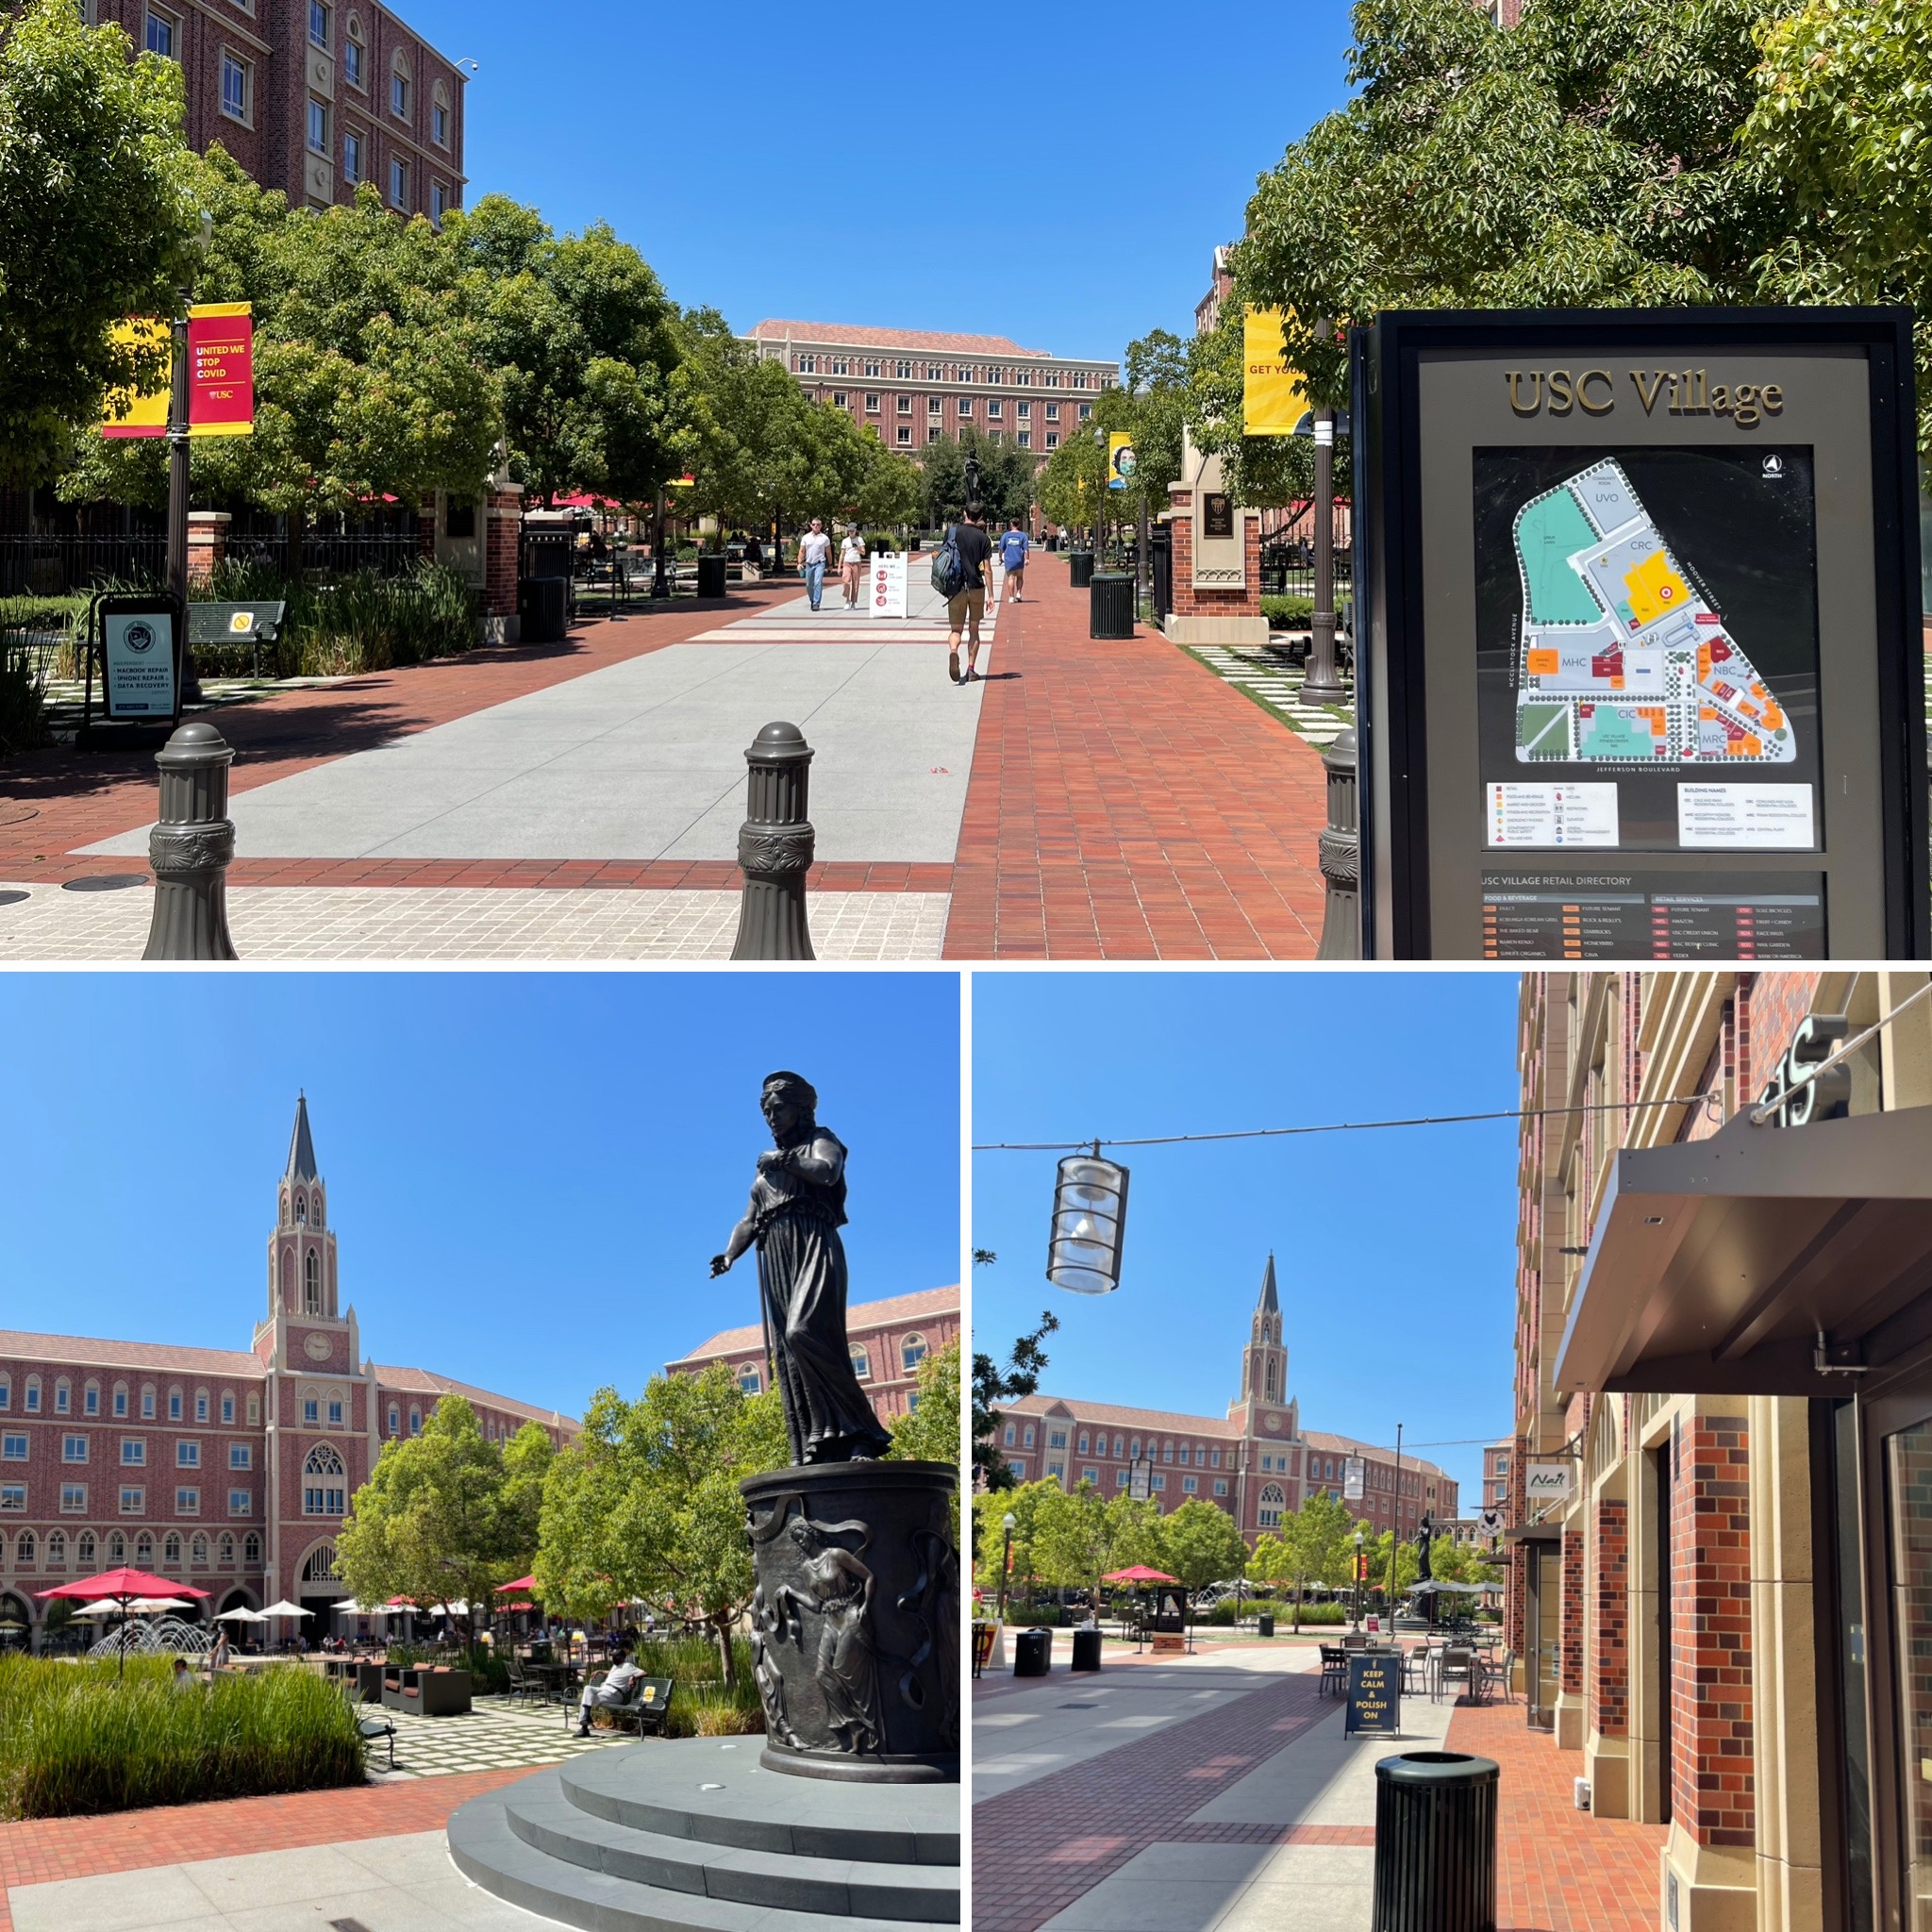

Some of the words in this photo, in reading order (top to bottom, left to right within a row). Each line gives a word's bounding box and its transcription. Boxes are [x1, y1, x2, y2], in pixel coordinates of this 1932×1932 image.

[196, 345, 229, 356] UNITED
[230, 344, 245, 354] WE
[196, 358, 220, 367] STOP
[196, 369, 226, 379] COVID
[1249, 365, 1272, 375] GET
[1274, 365, 1306, 375] YOU
[216, 390, 233, 399] USC
[1505, 369, 1614, 412] USC
[1629, 368, 1784, 425] Village
[1595, 493, 1619, 503] UVO
[1630, 541, 1653, 550] CRC
[1686, 561, 1707, 588] HOOVER
[1704, 588, 1722, 610] STREET
[1561, 658, 1587, 667] MHC
[1713, 666, 1737, 675] NBC
[1618, 709, 1637, 719] CIC
[1702, 734, 1726, 743] MRC
[1481, 876, 1499, 885] USC
[1502, 876, 1541, 885] VILLAGE
[1576, 876, 1632, 885] DIRECTORY
[1530, 1472, 1565, 1487] Nail
